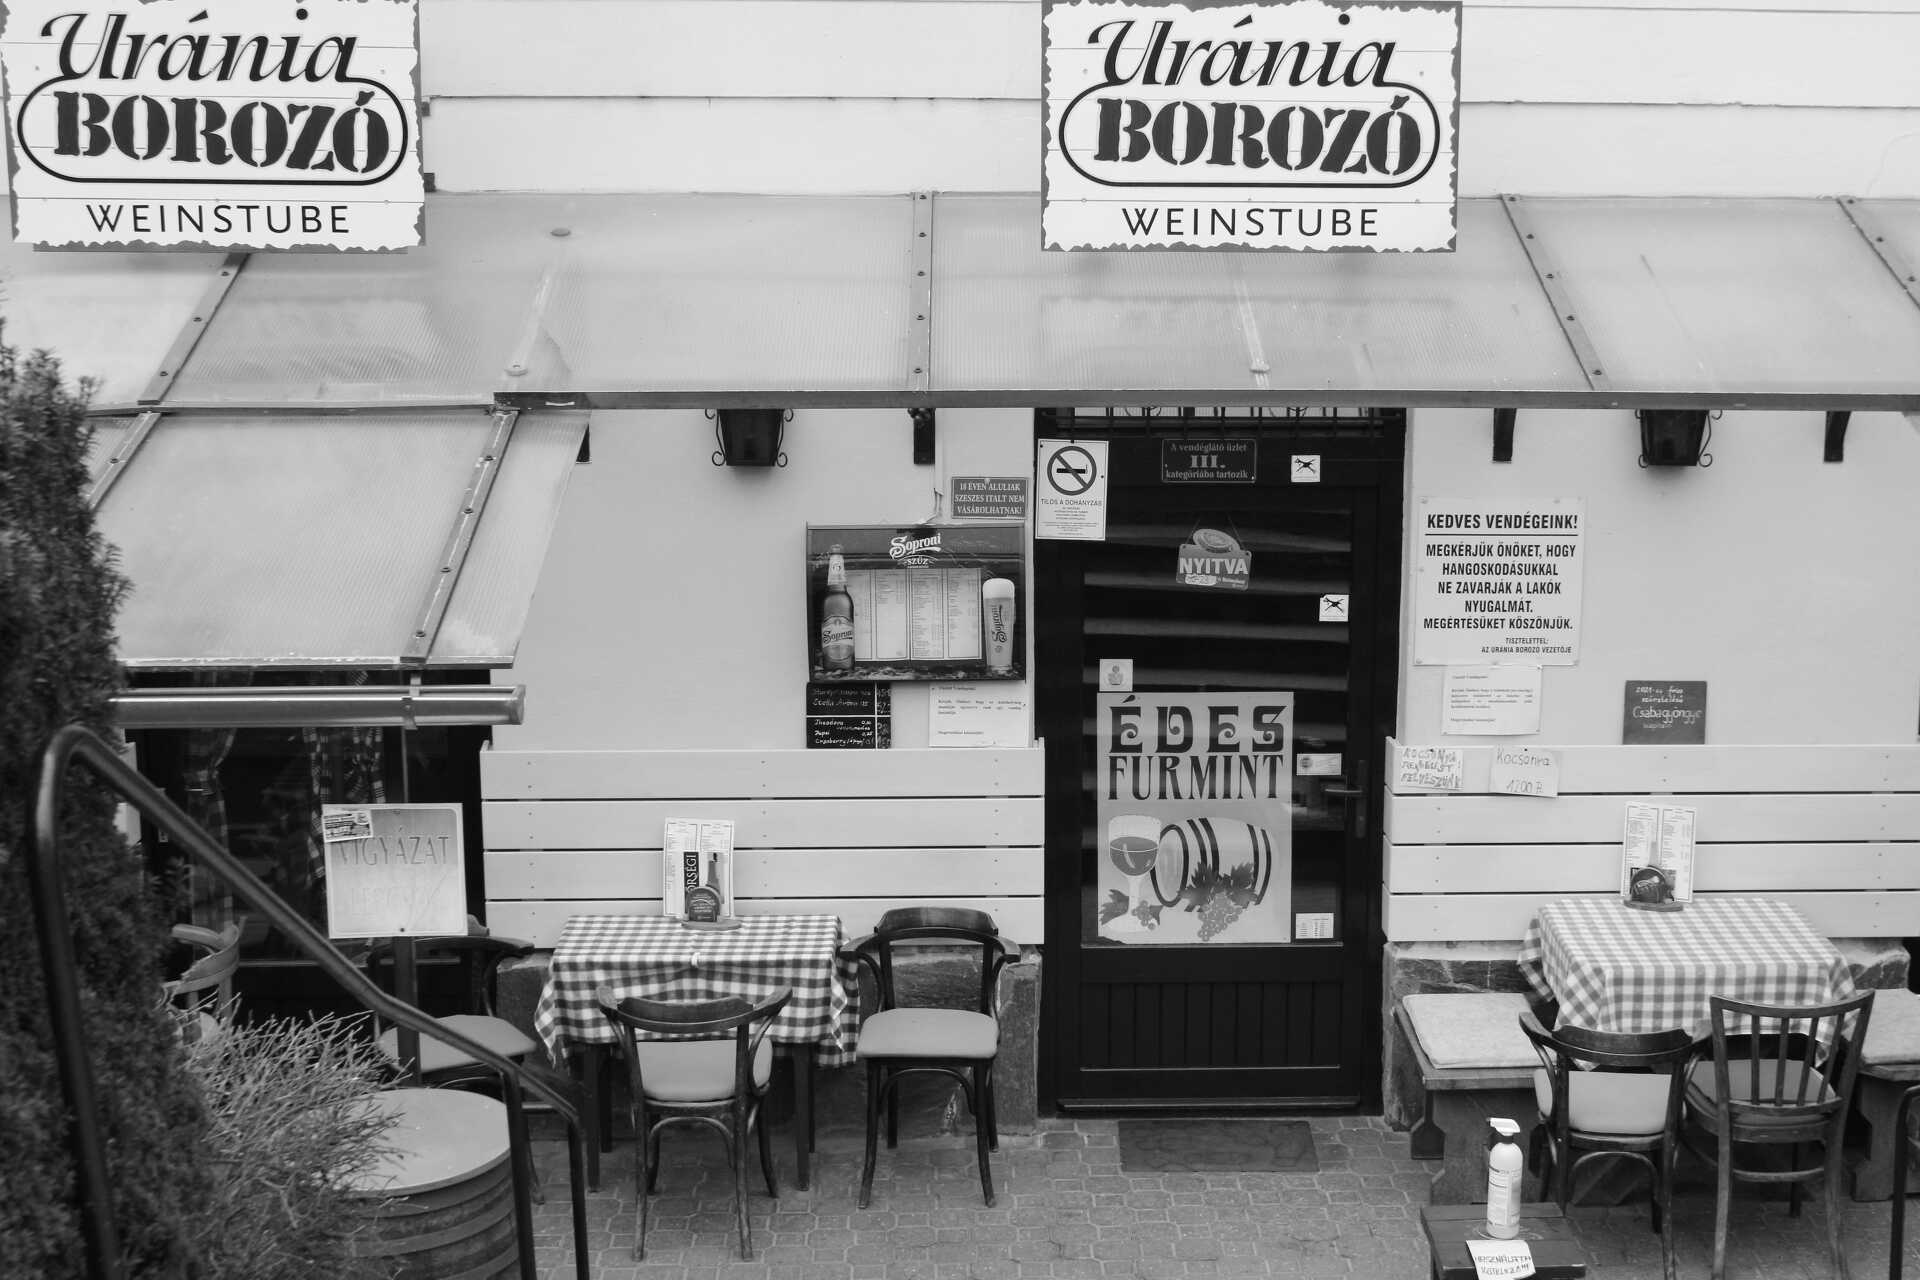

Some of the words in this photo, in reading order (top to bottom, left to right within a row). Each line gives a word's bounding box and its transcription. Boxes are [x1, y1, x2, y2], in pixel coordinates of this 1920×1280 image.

[41, 8, 356, 81] Uránia
[1087, 13, 1396, 87] Uránia
[53, 91, 390, 174] BOROZÓ
[1093, 96, 1422, 176] BOROZÓ
[86, 204, 350, 234] WEINSTUBE
[1122, 208, 1379, 237] WEINSTUBE
[1226, 442, 1247, 452] üzlet
[1190, 454, 1226, 469] III.
[1217, 469, 1249, 479] tartozik
[988, 482, 1020, 491] ALULIAK
[954, 494, 985, 503] SZESZES
[985, 494, 1007, 503] ITALT
[1008, 494, 1025, 503] NEM
[1427, 514, 1481, 529] KEDVES
[1486, 511, 1578, 529] VENDÉGEINK!
[890, 532, 941, 560] Soproni
[1426, 541, 1494, 557] MEGKÉRJÜK
[1497, 541, 1542, 559] ÖNÖKET,
[1546, 544, 1576, 557] HOGY
[1179, 556, 1249, 575] NYITVA
[1442, 560, 1559, 576] HANGOSKODÁSUKKAL
[1438, 581, 1452, 594] NE
[1456, 578, 1512, 594] ZAVARJÁK
[1515, 582, 1523, 594] A
[1526, 579, 1561, 594] LAKÓK
[1464, 597, 1533, 613] NYUGALMÁT.
[991, 603, 1007, 643] Soproni
[1423, 615, 1505, 629] MEGÉRTÉSÜKET
[1509, 615, 1573, 630] KÖSZÖNJÜK.
[1109, 694, 1287, 753] ÉDES
[1632, 705, 1703, 725] Csabagyöngye
[1108, 754, 1284, 800] FURMINT
[339, 826, 449, 866] VIGYÁZAT
